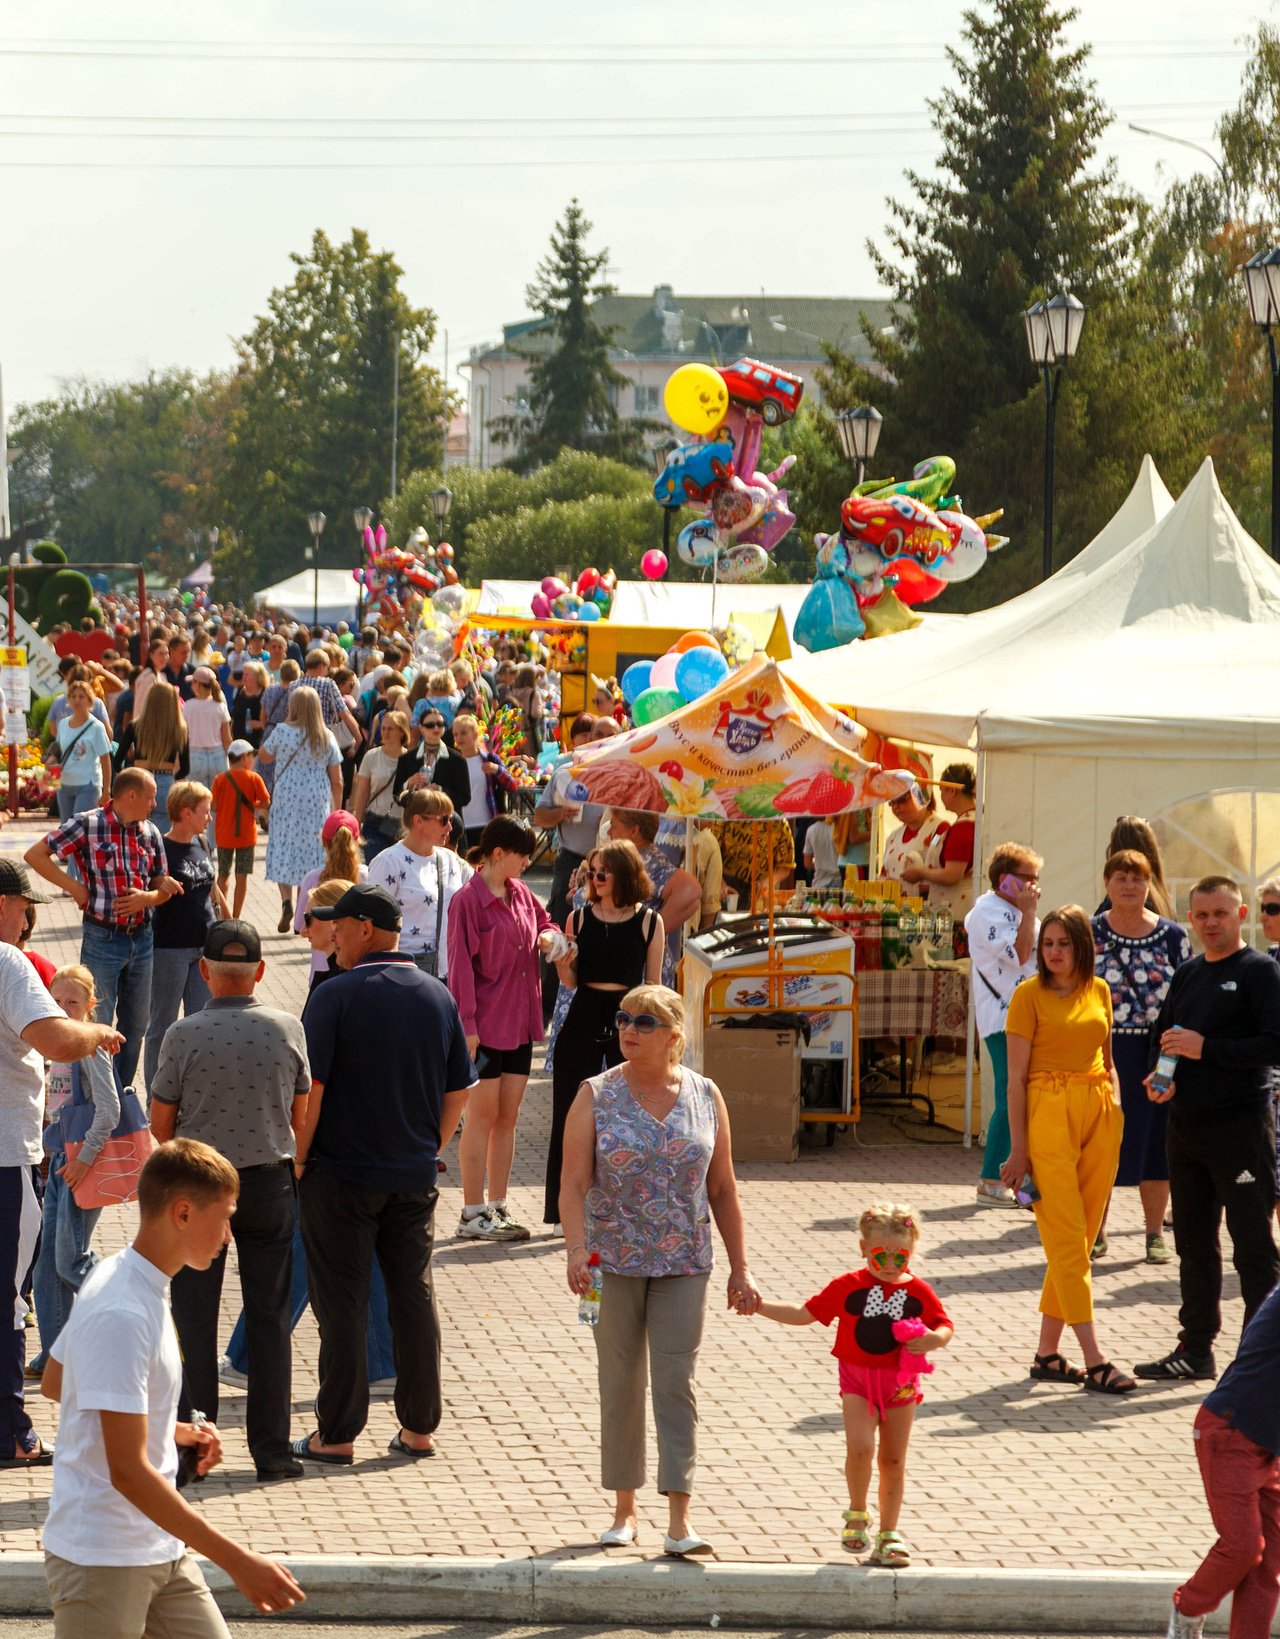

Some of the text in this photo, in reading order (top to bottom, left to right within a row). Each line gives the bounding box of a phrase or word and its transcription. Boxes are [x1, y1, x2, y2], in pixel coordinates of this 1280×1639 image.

[669, 721, 812, 777] Вкус и качество без грани
